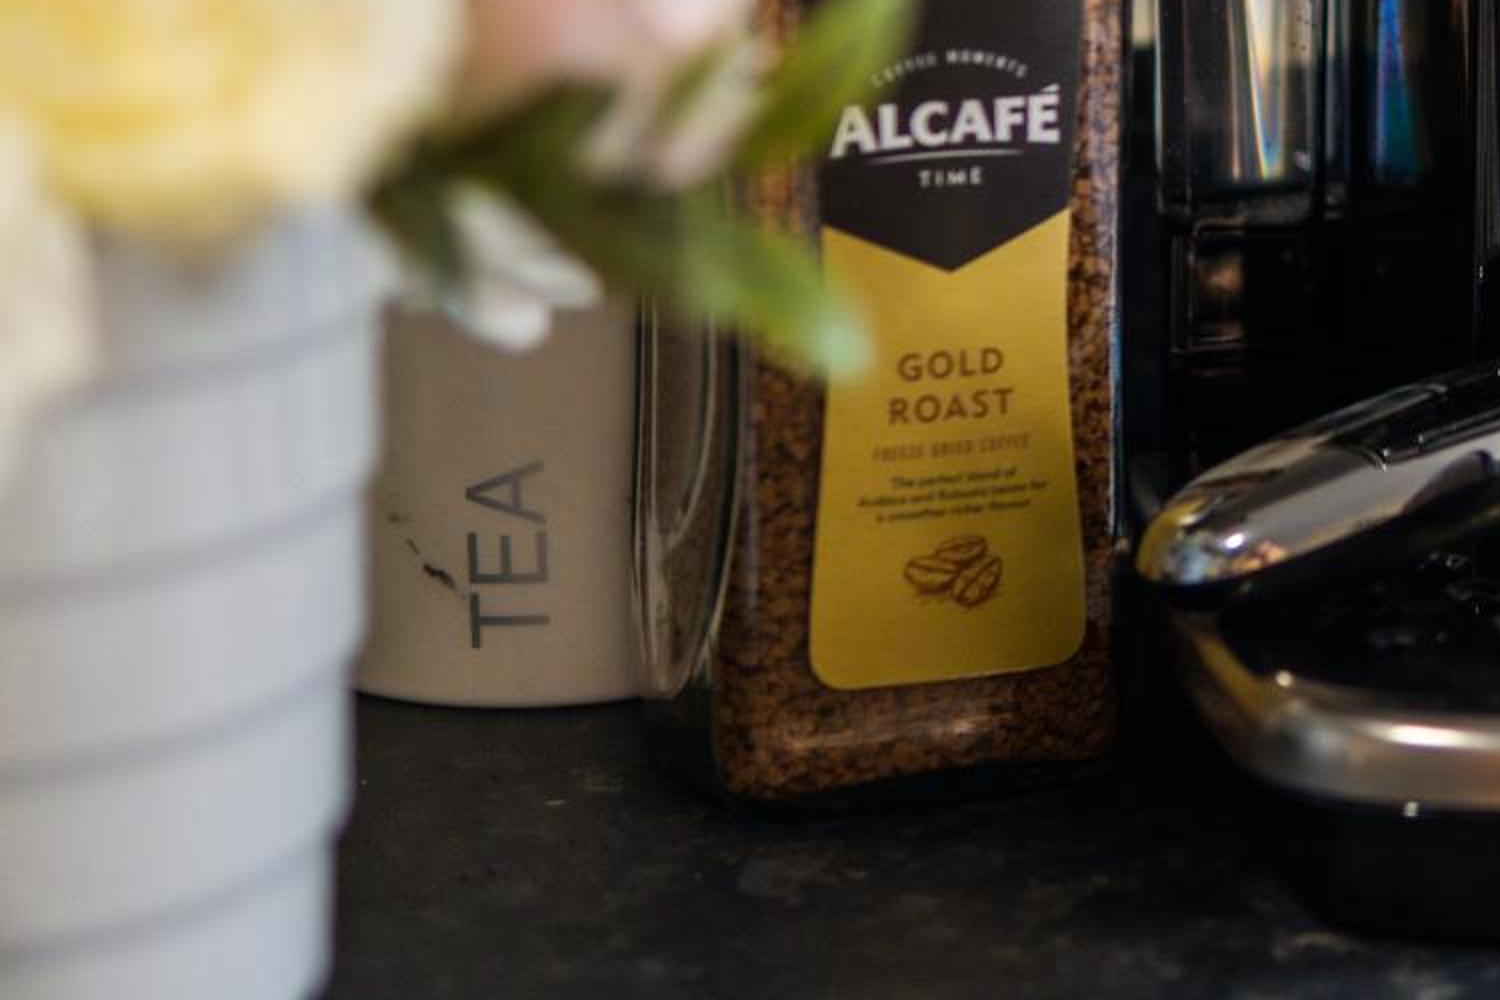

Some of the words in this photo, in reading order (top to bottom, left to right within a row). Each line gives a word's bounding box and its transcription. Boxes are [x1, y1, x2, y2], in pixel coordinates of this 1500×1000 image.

[829, 83, 1061, 159] ALCAFÉ
[919, 166, 984, 189] TIME
[897, 346, 1004, 382] GOLD
[888, 387, 1014, 426] ROAST
[465, 458, 550, 649] TEA
